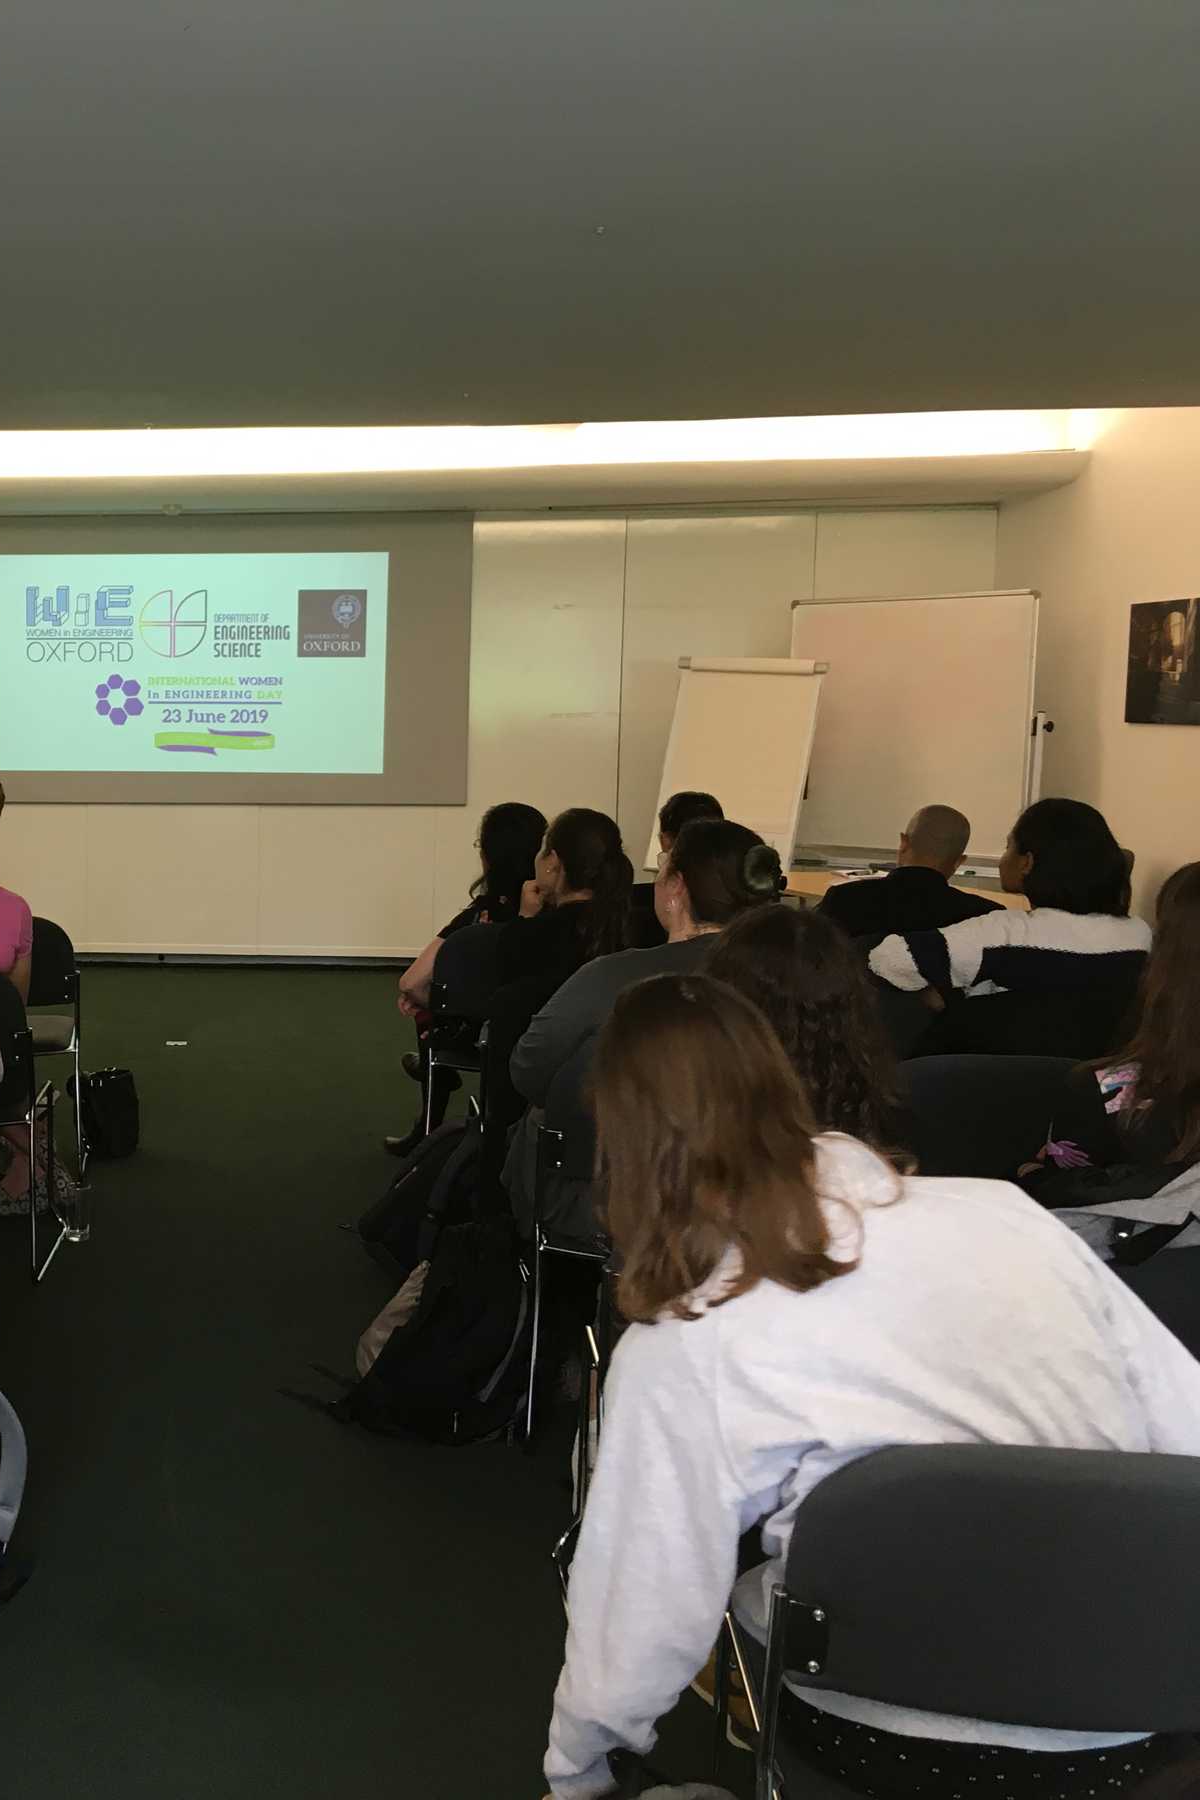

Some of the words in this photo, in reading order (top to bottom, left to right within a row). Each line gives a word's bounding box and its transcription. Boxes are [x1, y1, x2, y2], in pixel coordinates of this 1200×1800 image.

[214, 613, 259, 623] DEPARTMENT
[261, 613, 270, 623] OF
[26, 629, 62, 637] WOMEN
[73, 629, 133, 637] ENGINEERING
[214, 625, 290, 640] ENGINEERING
[26, 641, 134, 662] OXFORD
[213, 642, 262, 658] SCIENCE
[303, 640, 361, 652] OXFORD
[147, 676, 235, 686] INTERNATIONAL
[238, 676, 283, 686] WOMEN
[165, 690, 253, 699] ENGINEERING
[256, 690, 283, 699] DAY
[162, 709, 182, 723] 23
[185, 709, 226, 723] June
[230, 709, 269, 723] 2019
